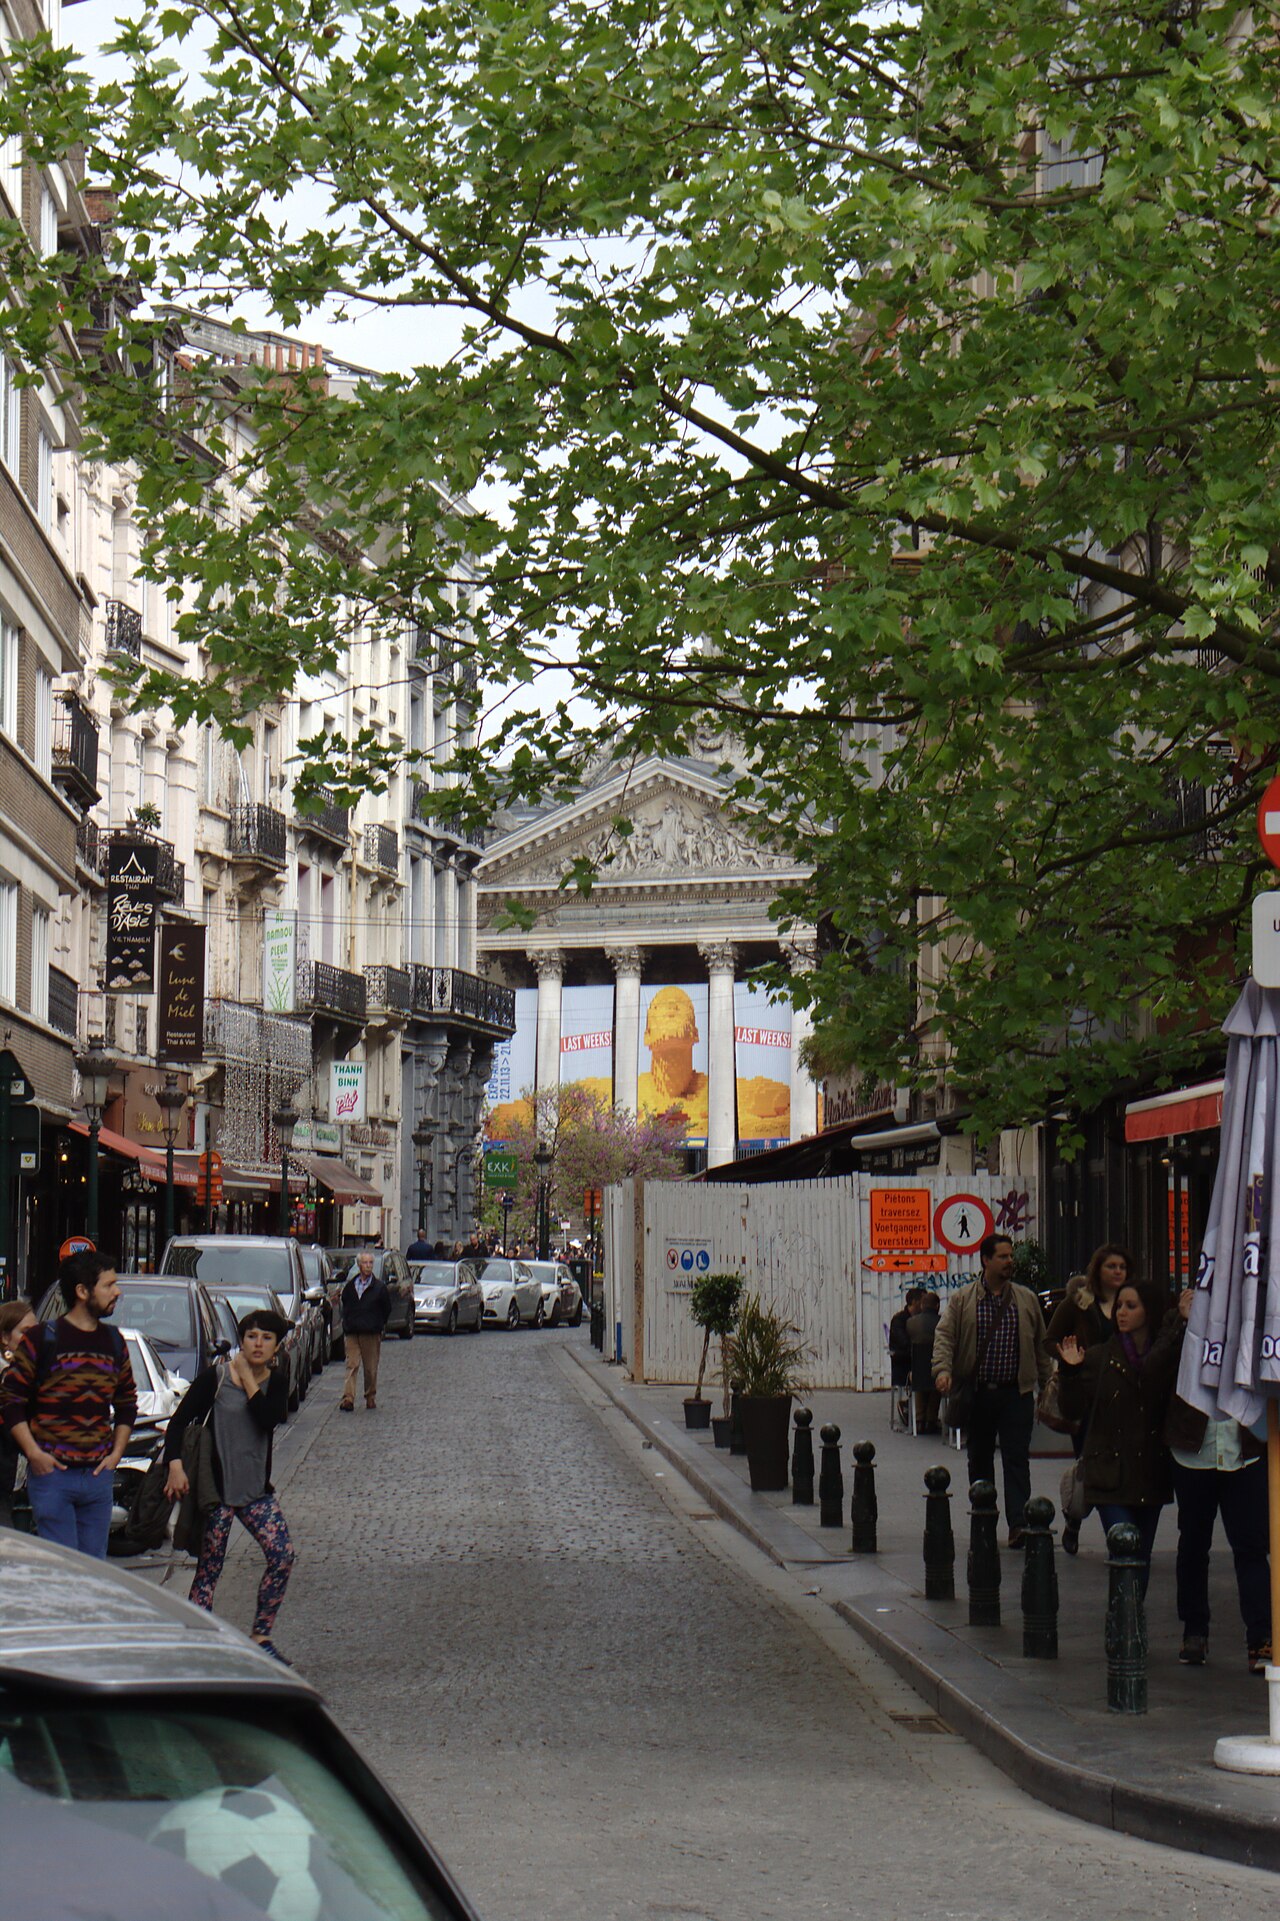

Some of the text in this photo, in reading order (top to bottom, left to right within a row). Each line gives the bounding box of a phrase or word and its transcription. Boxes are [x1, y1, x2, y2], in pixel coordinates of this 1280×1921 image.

[110, 874, 154, 885] RESTAURANT
[276, 912, 284, 922] AU
[168, 970, 196, 985] Lune
[174, 987, 190, 1001] de
[167, 1003, 196, 1018] Miel
[179, 1038, 184, 1046] &
[563, 1031, 612, 1051] LAST WEEKS!
[737, 1027, 791, 1048] LAST WEEKS!
[334, 1065, 363, 1074] THANH
[338, 1078, 359, 1087] BINH
[499, 1066, 511, 1100] 22.11.13
[884, 1193, 917, 1203] Piétons
[880, 1207, 921, 1218] traversez
[875, 1222, 927, 1235] Voetgangers
[877, 1236, 924, 1247] oversteken
